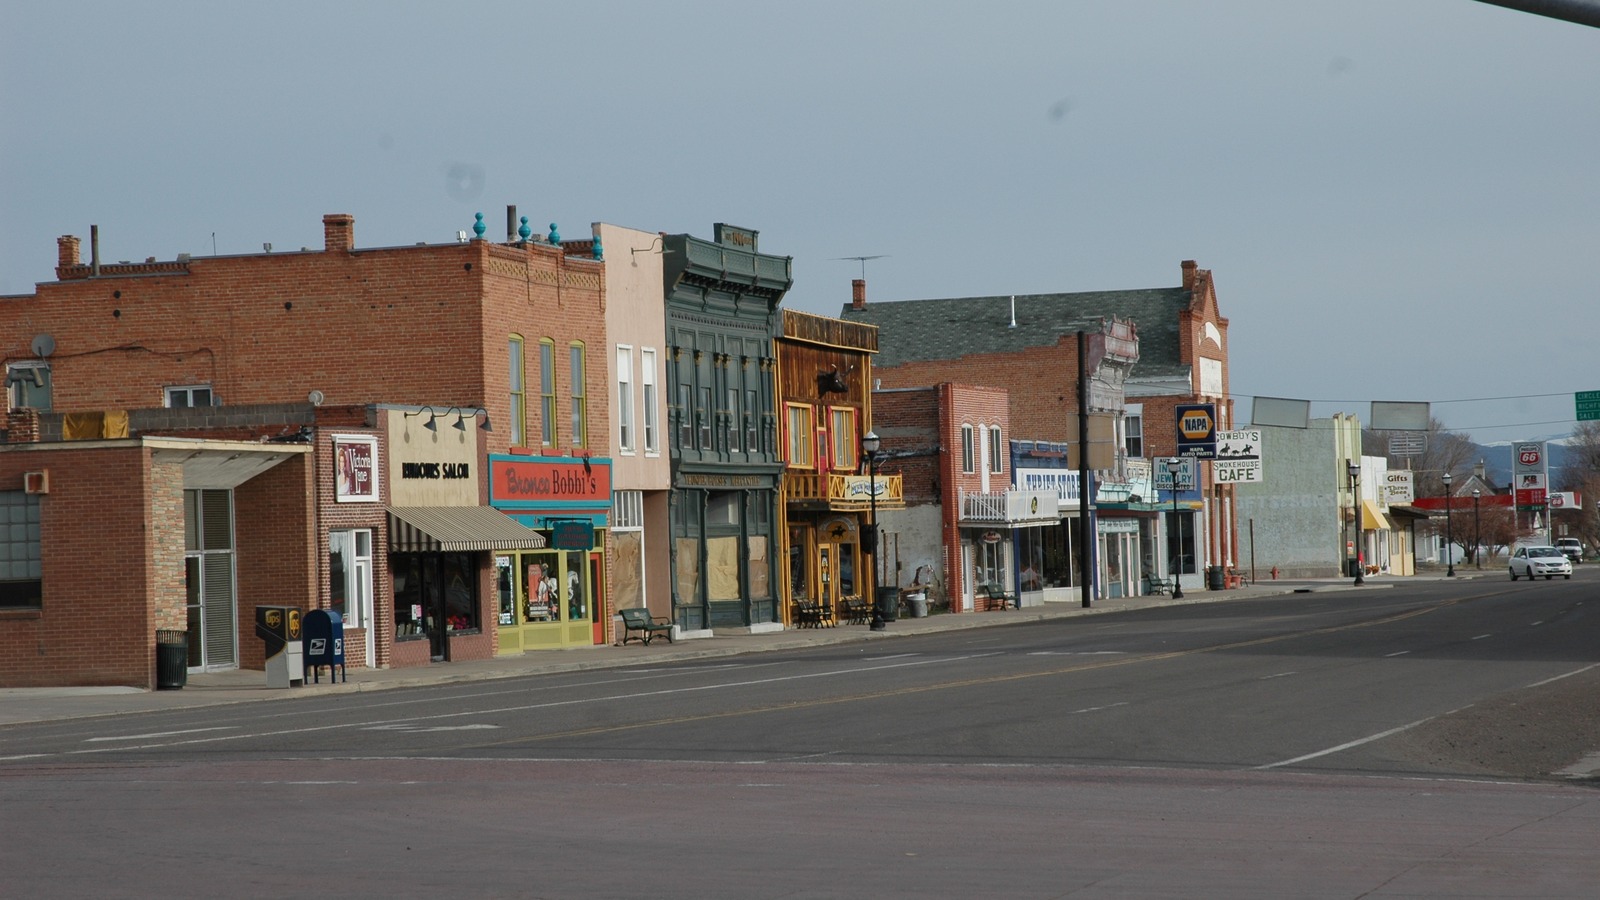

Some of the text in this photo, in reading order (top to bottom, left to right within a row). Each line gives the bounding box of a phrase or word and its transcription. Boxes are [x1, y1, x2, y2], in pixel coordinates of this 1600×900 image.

[1184, 418, 1208, 431] NAPA
[348, 448, 371, 473] Victoria
[1522, 452, 1537, 462] 66
[402, 462, 469, 479] RUMOURS SALON
[1213, 461, 1260, 471] SMOKEHOUSE
[505, 467, 596, 495] Bronco Bobbi's
[1155, 474, 1192, 483] JEWLRY
[1218, 468, 1255, 481] CAFE
[354, 469, 368, 494] Lane
[266, 614, 280, 627] ups
[290, 619, 300, 635] ups
